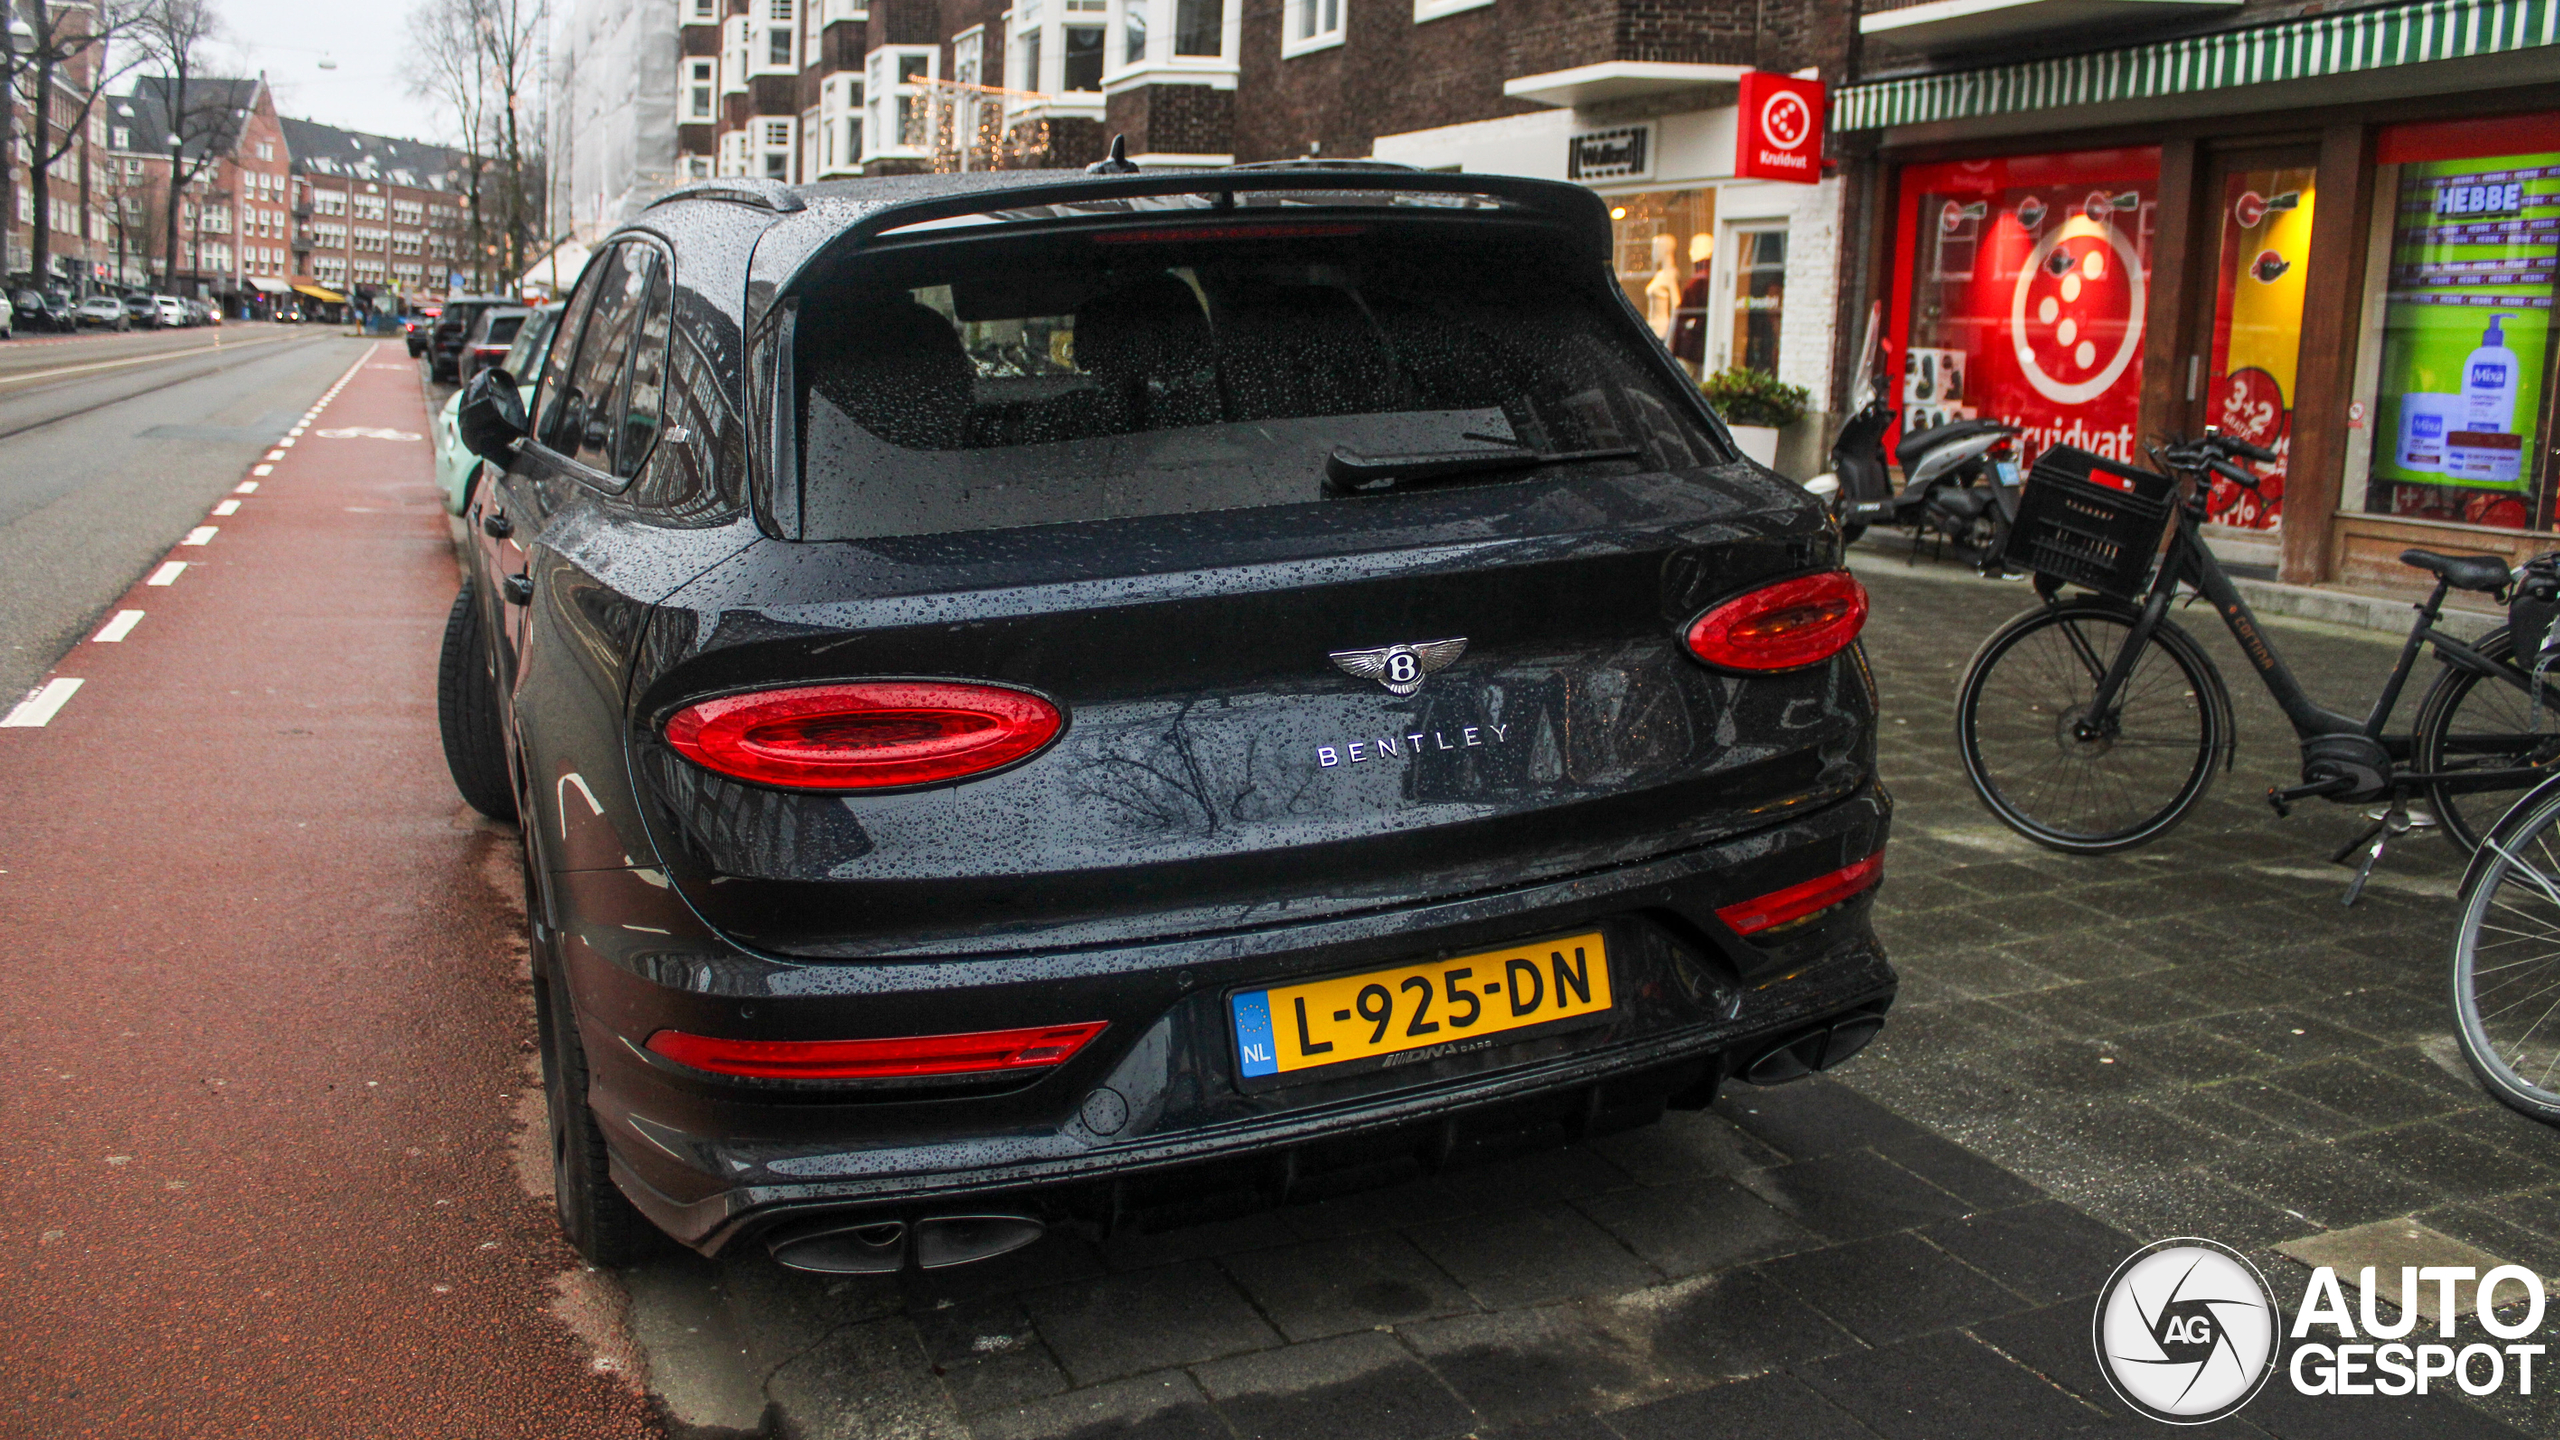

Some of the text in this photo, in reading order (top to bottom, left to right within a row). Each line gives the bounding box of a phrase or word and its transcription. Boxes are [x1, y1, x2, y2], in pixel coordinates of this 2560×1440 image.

[1760, 149, 1808, 169] Kruidvat
[2436, 183, 2522, 214] HEBBE
[2473, 367, 2505, 384] Mixa
[2224, 380, 2274, 437] 3+2
[2413, 417, 2441, 432] Mixa
[1389, 654, 1416, 682] B
[1317, 723, 1508, 768] BENTLEY
[1294, 947, 1592, 1057] L-925-DN
[1243, 1043, 1271, 1065] NL
[1404, 1043, 1459, 1064] DNA
